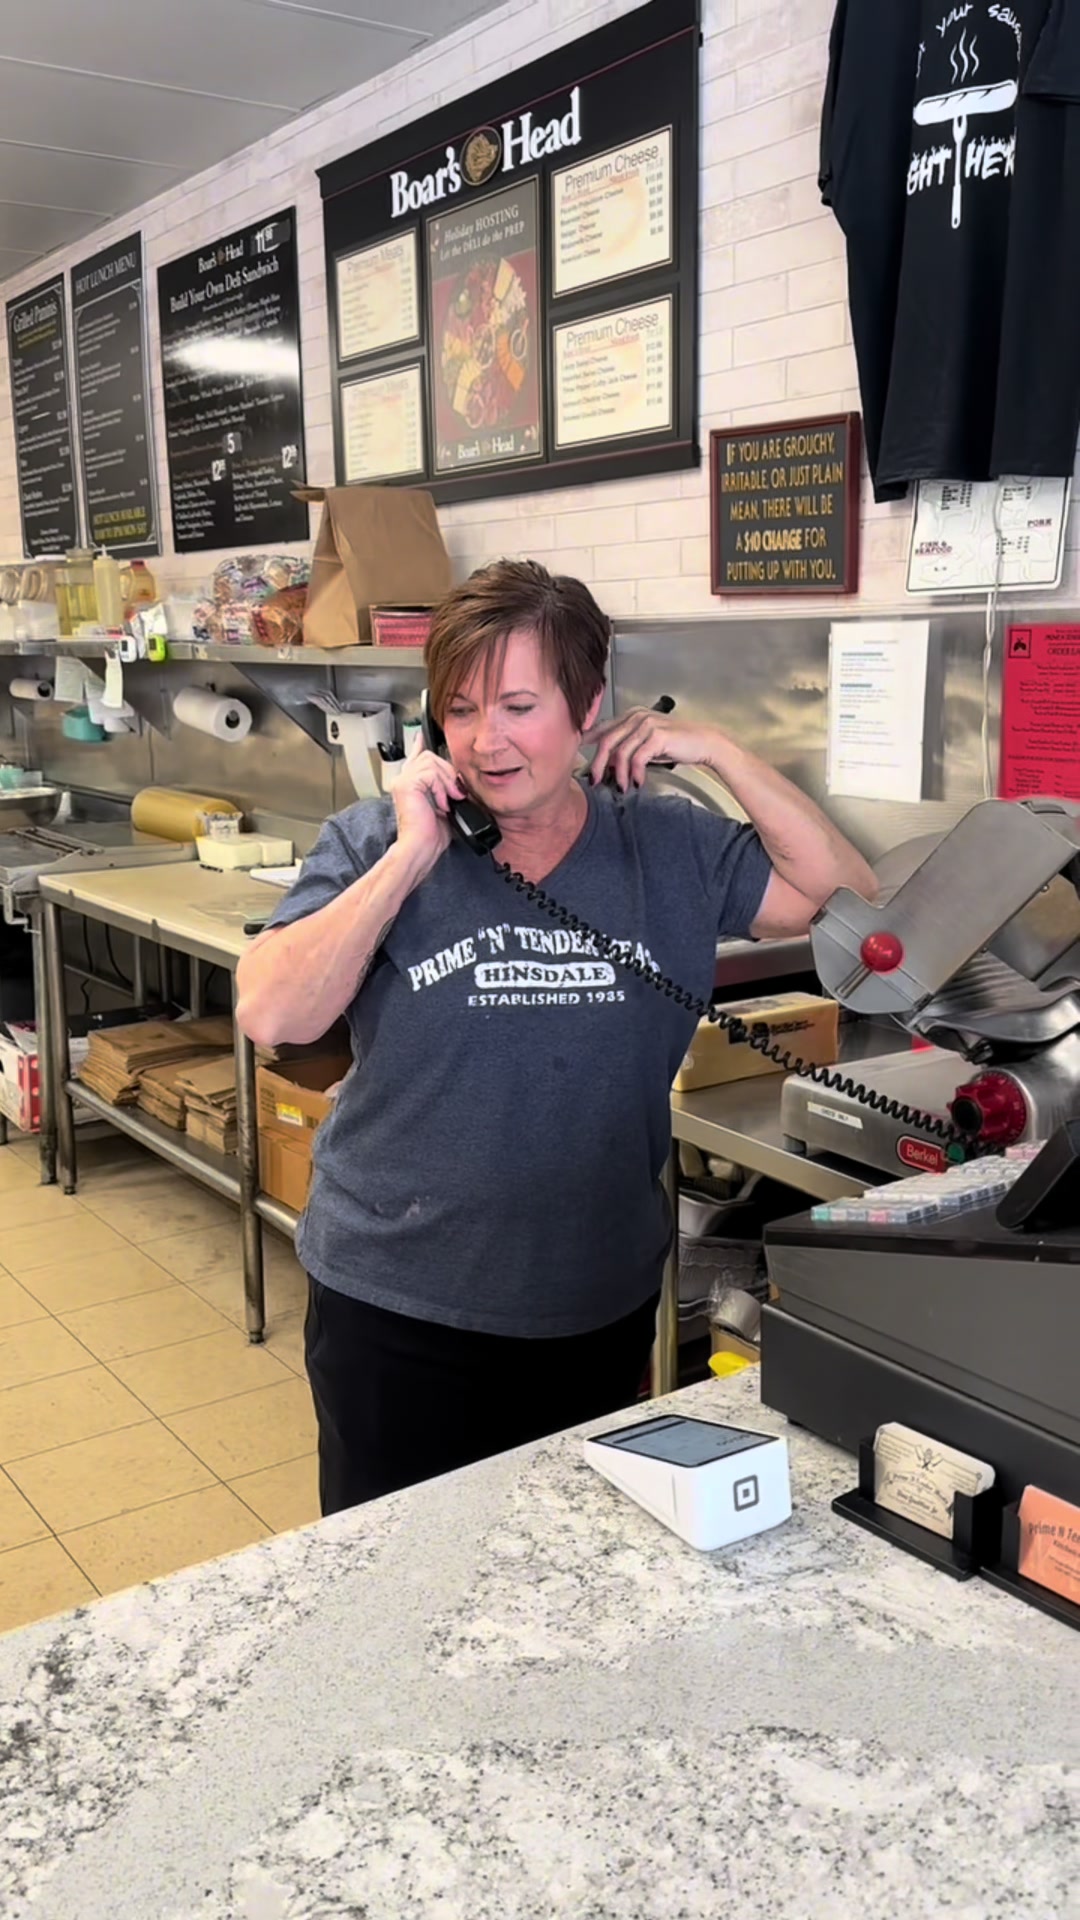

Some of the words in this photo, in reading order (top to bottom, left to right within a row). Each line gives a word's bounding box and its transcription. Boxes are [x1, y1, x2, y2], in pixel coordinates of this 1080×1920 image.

[936, 3, 974, 38] your
[390, 146, 463, 219] Boar's
[501, 85, 582, 173] Head
[564, 162, 612, 193] Premium
[614, 145, 659, 174] Cheese
[443, 223, 474, 245] Holiday
[475, 203, 519, 232] HOSTING
[504, 220, 524, 239] PREP
[225, 239, 244, 262] Head
[90, 267, 114, 288] LUNCH
[114, 251, 137, 275] MENU
[169, 291, 188, 313] Build
[188, 288, 205, 305] Your
[205, 281, 225, 299] Own
[225, 270, 241, 291] Deli
[242, 254, 279, 285] Sandwich
[565, 325, 613, 350] Premium
[615, 313, 659, 337] Cheese
[727, 443, 736, 466] IF
[739, 441, 759, 462] YOU
[761, 438, 781, 460] ARE
[770, 466, 787, 489] OR
[788, 464, 811, 487] JUST
[812, 461, 844, 485] PLAIN
[762, 497, 792, 519] THERE
[794, 495, 819, 517] WILL
[820, 493, 833, 515] BE
[735, 532, 744, 551] A
[744, 530, 761, 554] $10
[762, 528, 802, 552] CHARGE
[804, 526, 827, 548] FOR
[726, 561, 765, 582] PUTTING
[767, 560, 780, 580] UP
[782, 559, 807, 580] WITH
[809, 558, 837, 580] YOU.
[407, 937, 477, 992] PRIME
[484, 965, 608, 983] HINSDALE
[467, 992, 580, 1006] ESTABLISHED
[906, 1143, 939, 1165] Berkel
